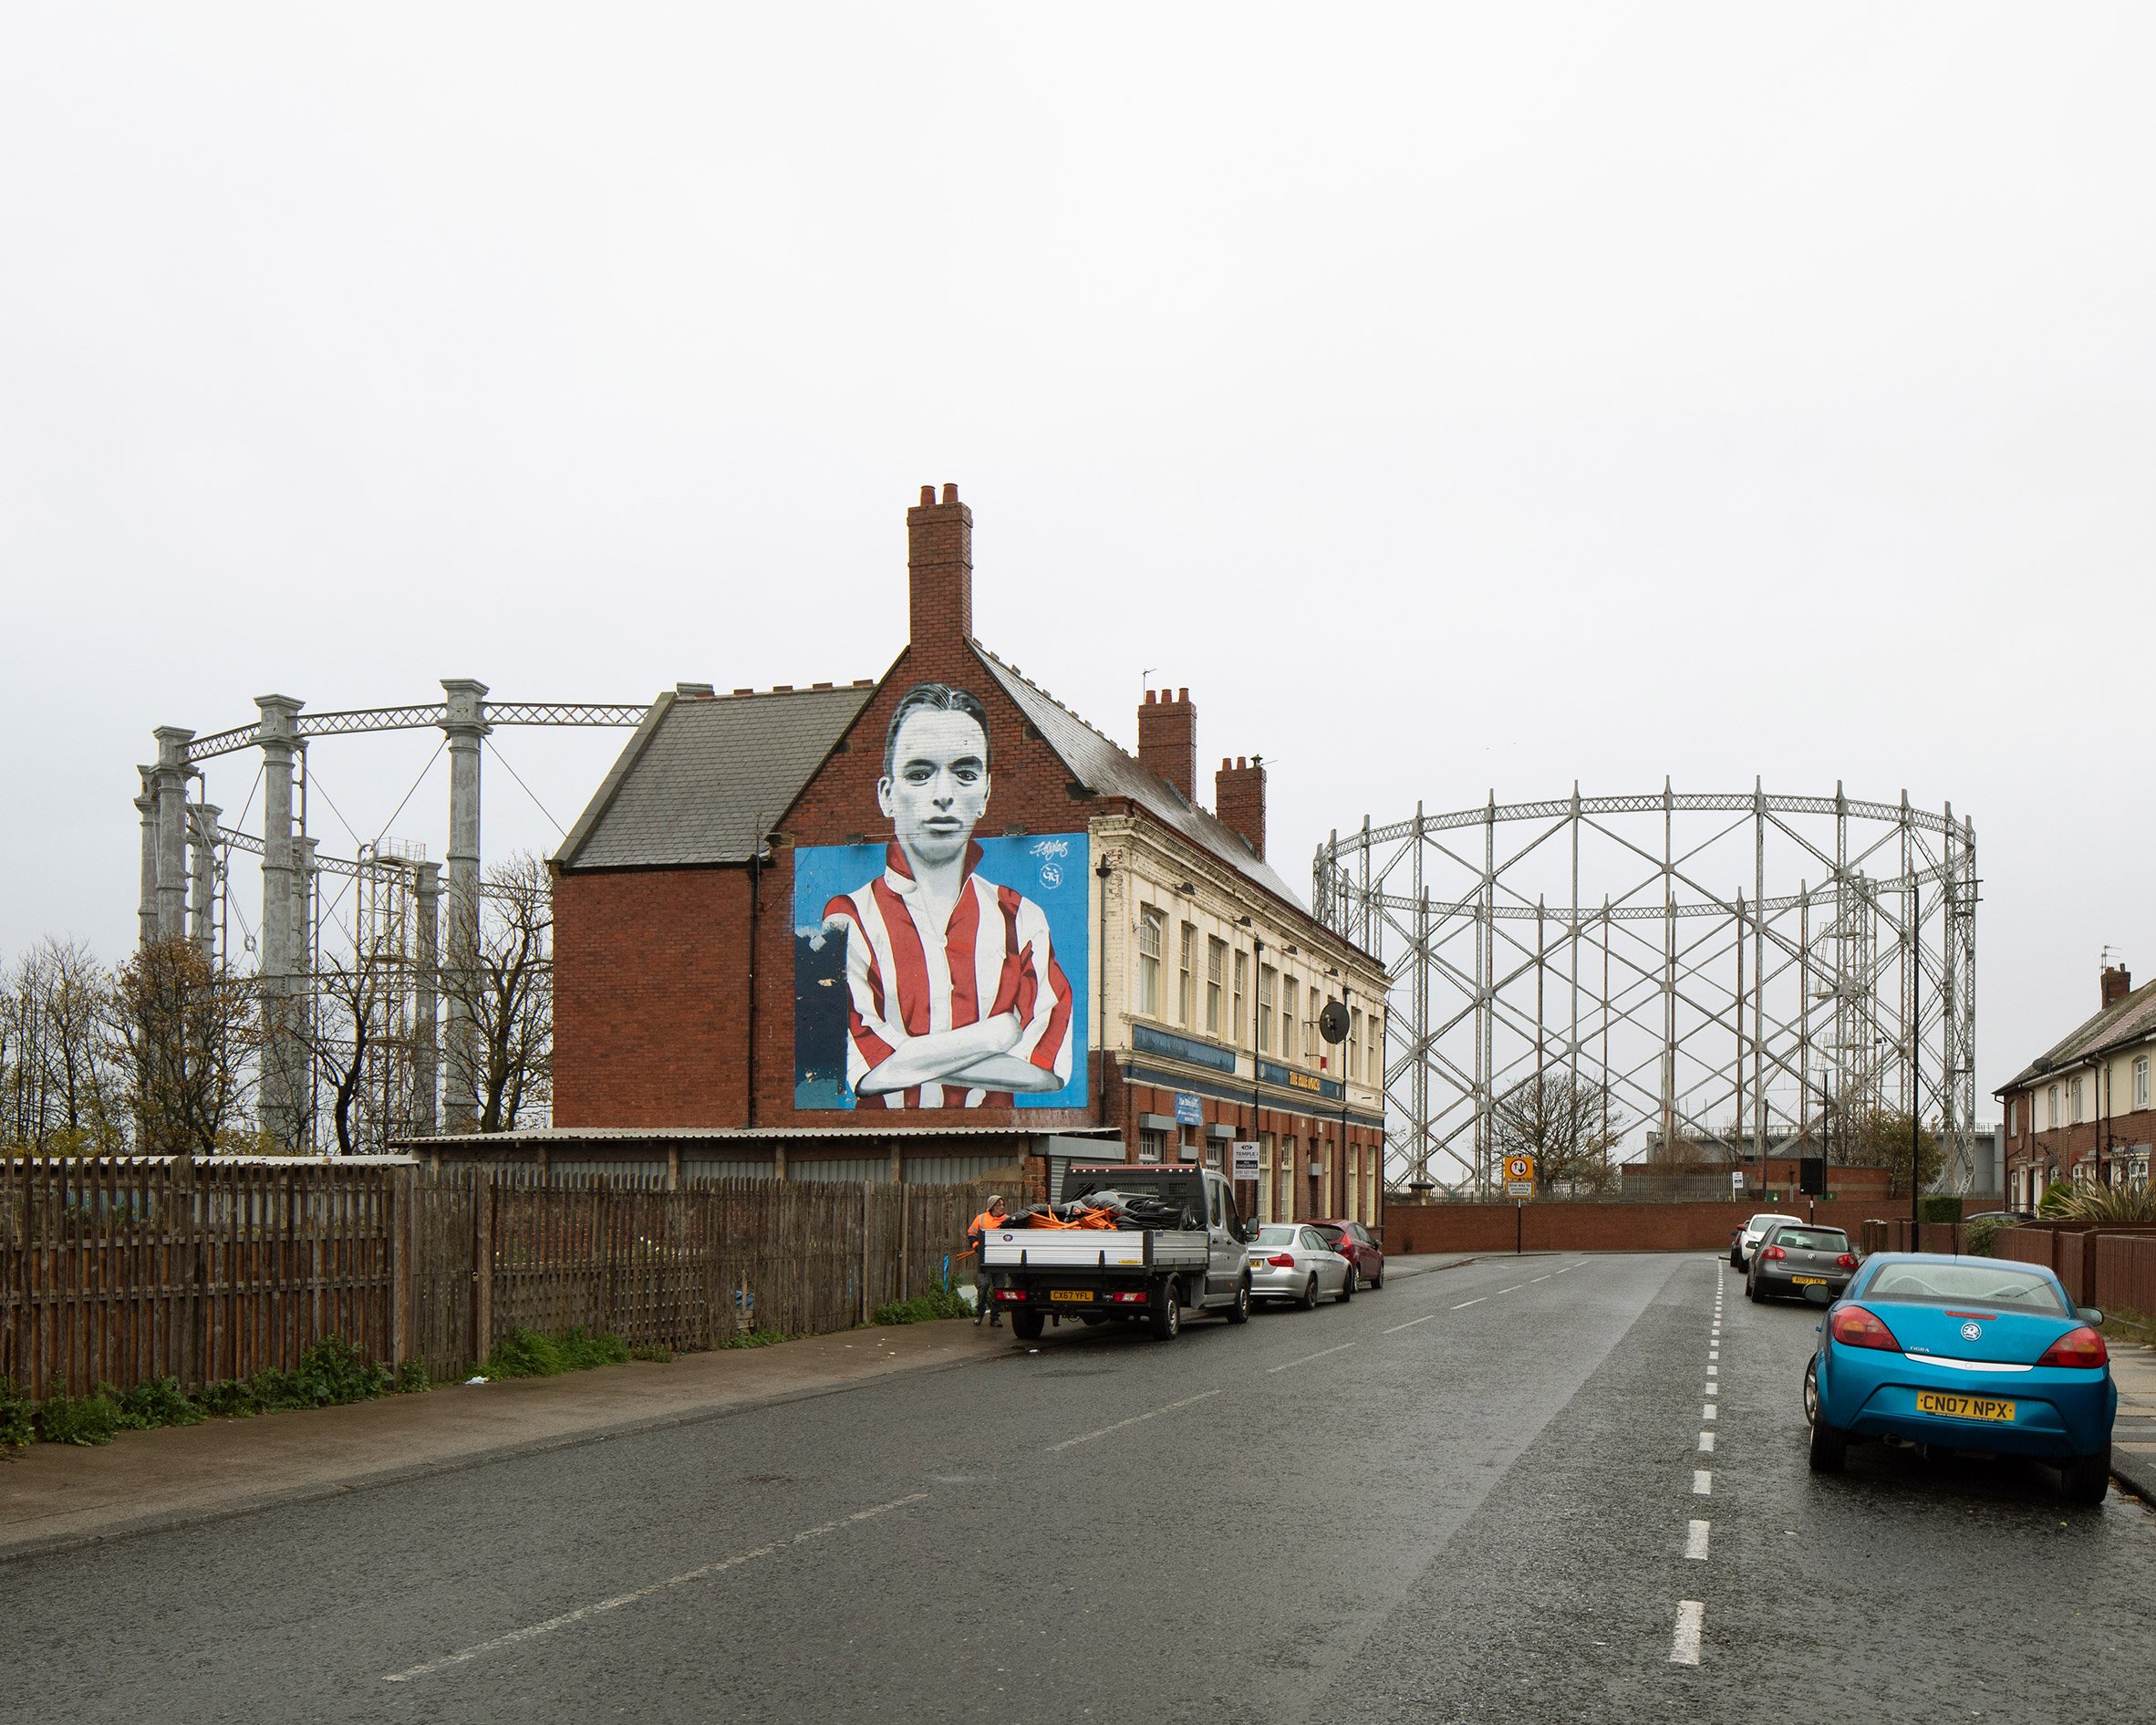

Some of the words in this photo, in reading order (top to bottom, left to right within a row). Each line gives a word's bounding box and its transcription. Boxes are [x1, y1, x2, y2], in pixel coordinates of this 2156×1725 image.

[1053, 1291, 1073, 1300] CX67
[1074, 1292, 1090, 1300] YFL
[1923, 1395, 1969, 1414] CN07
[1973, 1400, 2008, 1418] NPX
